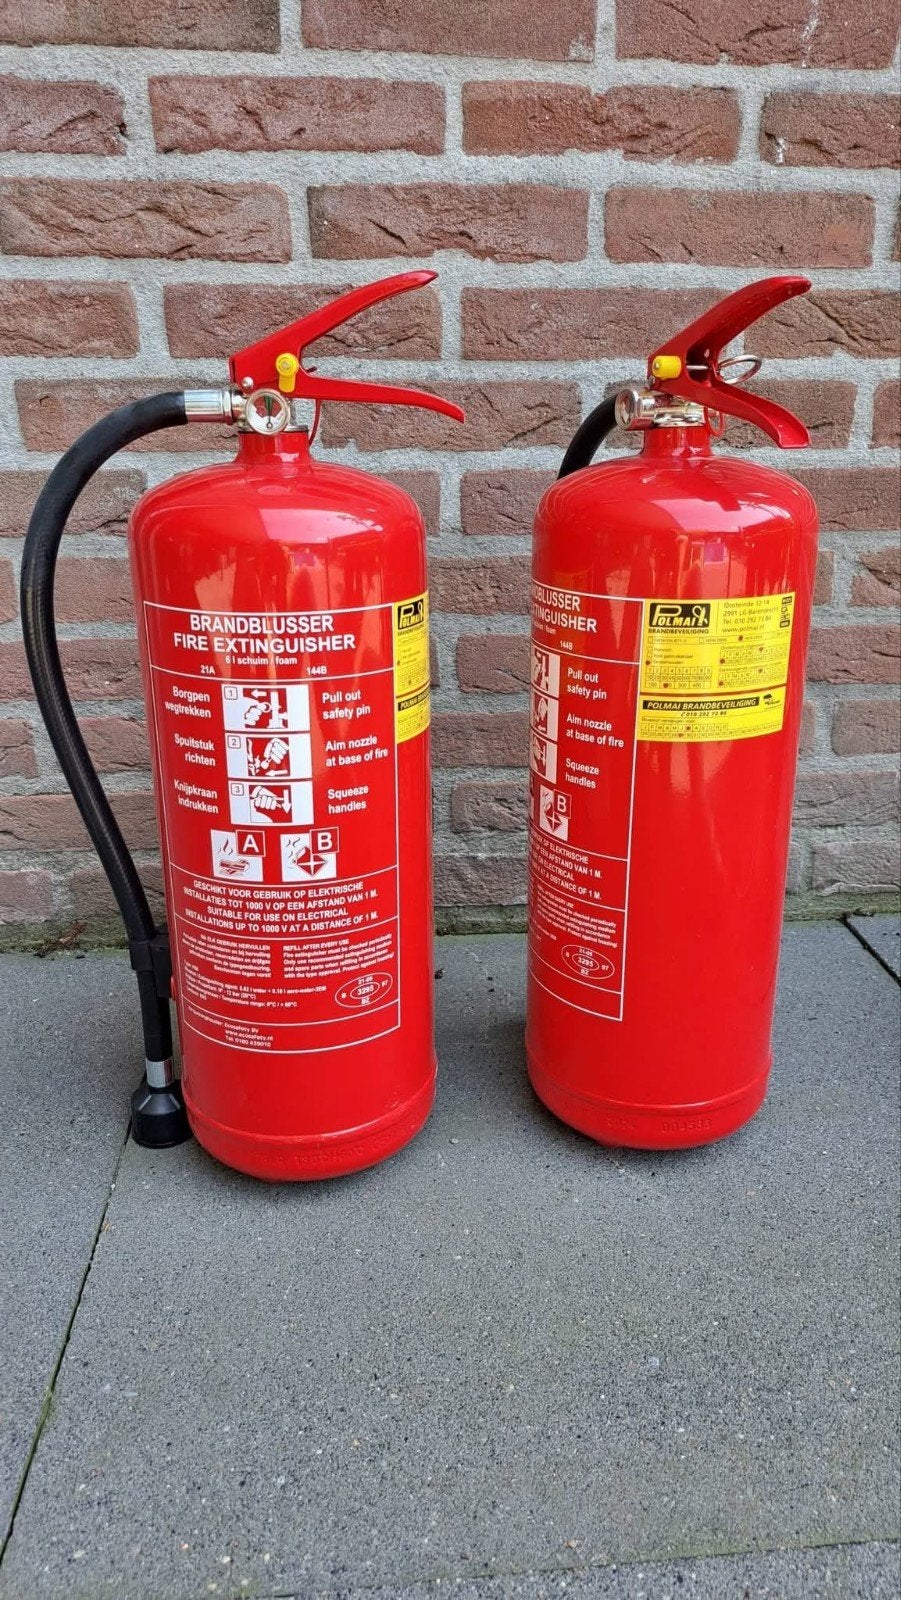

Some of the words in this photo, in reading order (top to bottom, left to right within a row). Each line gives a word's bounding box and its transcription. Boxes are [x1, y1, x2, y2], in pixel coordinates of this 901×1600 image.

[190, 614, 334, 634] BRANDBLUSSER
[174, 632, 209, 651] FIRE
[213, 634, 356, 654] EXTINGUISHER
[560, 640, 573, 650] 144B
[225, 655, 231, 664] 6
[237, 656, 269, 665] schuim
[275, 656, 298, 665] foam
[200, 665, 215, 674] 21A
[306, 665, 327, 675] 144B
[567, 667, 583, 680] Pull
[584, 672, 599, 683] out
[172, 685, 210, 703] Borgpen
[322, 691, 342, 703] Pull
[345, 689, 361, 700] out
[567, 684, 591, 700] safety
[592, 688, 607, 700] pin
[164, 701, 212, 718] wegtrekken
[322, 706, 354, 720] safety
[356, 704, 371, 717] pin
[646, 701, 682, 711] POLMAI
[682, 697, 757, 711] BRANDBEVEILIGING
[566, 713, 582, 726] Aim
[584, 718, 613, 731] nozzle
[174, 733, 215, 751] Spuitstuk
[325, 740, 346, 752] Aim
[348, 734, 378, 749] nozzle
[566, 728, 574, 738] at
[575, 730, 595, 743] base
[597, 735, 607, 745] of
[608, 736, 625, 748] fire
[184, 752, 216, 766] richten
[325, 757, 336, 767] at
[338, 754, 362, 765] base
[364, 750, 374, 761] of
[375, 748, 388, 759] fire
[565, 757, 600, 776] Squeeze
[173, 779, 218, 799] Knijpkraan
[565, 772, 597, 789] handles
[327, 785, 369, 800] Squeeze
[178, 795, 219, 814] indrukken
[328, 800, 367, 814] handles
[557, 794, 567, 813] B
[242, 834, 259, 853] A
[317, 831, 333, 851] B
[574, 864, 588, 875] VAN
[589, 868, 593, 876] 1
[193, 880, 227, 894] GESCHIKT
[227, 888, 251, 898] VOOR
[253, 890, 292, 899] GEBRUIK
[293, 890, 306, 899] OP
[308, 881, 364, 898] ELEKTRISCHE
[578, 885, 588, 895] OF
[183, 886, 227, 906] INSTALLATIES
[228, 899, 243, 908] TOT
[245, 901, 263, 910] 1000
[265, 902, 271, 910] V
[272, 902, 285, 911] OP
[287, 901, 305, 910] EEN
[306, 897, 346, 909] AFSTAND
[347, 893, 364, 903] VAN
[364, 891, 369, 900] 1
[185, 908, 233, 930] INSTALLATIONS
[235, 922, 246, 931] UP
[248, 923, 259, 932] TO
[261, 924, 279, 933] 1000
[281, 924, 288, 933] V
[289, 924, 300, 933] AT
[302, 923, 309, 932] A
[311, 918, 352, 931] DISTANCE
[353, 915, 364, 925] OF
[364, 913, 369, 921] 1
[207, 905, 242, 919] SUITABLE
[244, 911, 261, 921] FOR
[263, 913, 280, 922] USE
[282, 912, 295, 922] ON
[297, 907, 349, 921] ELECTRICAL
